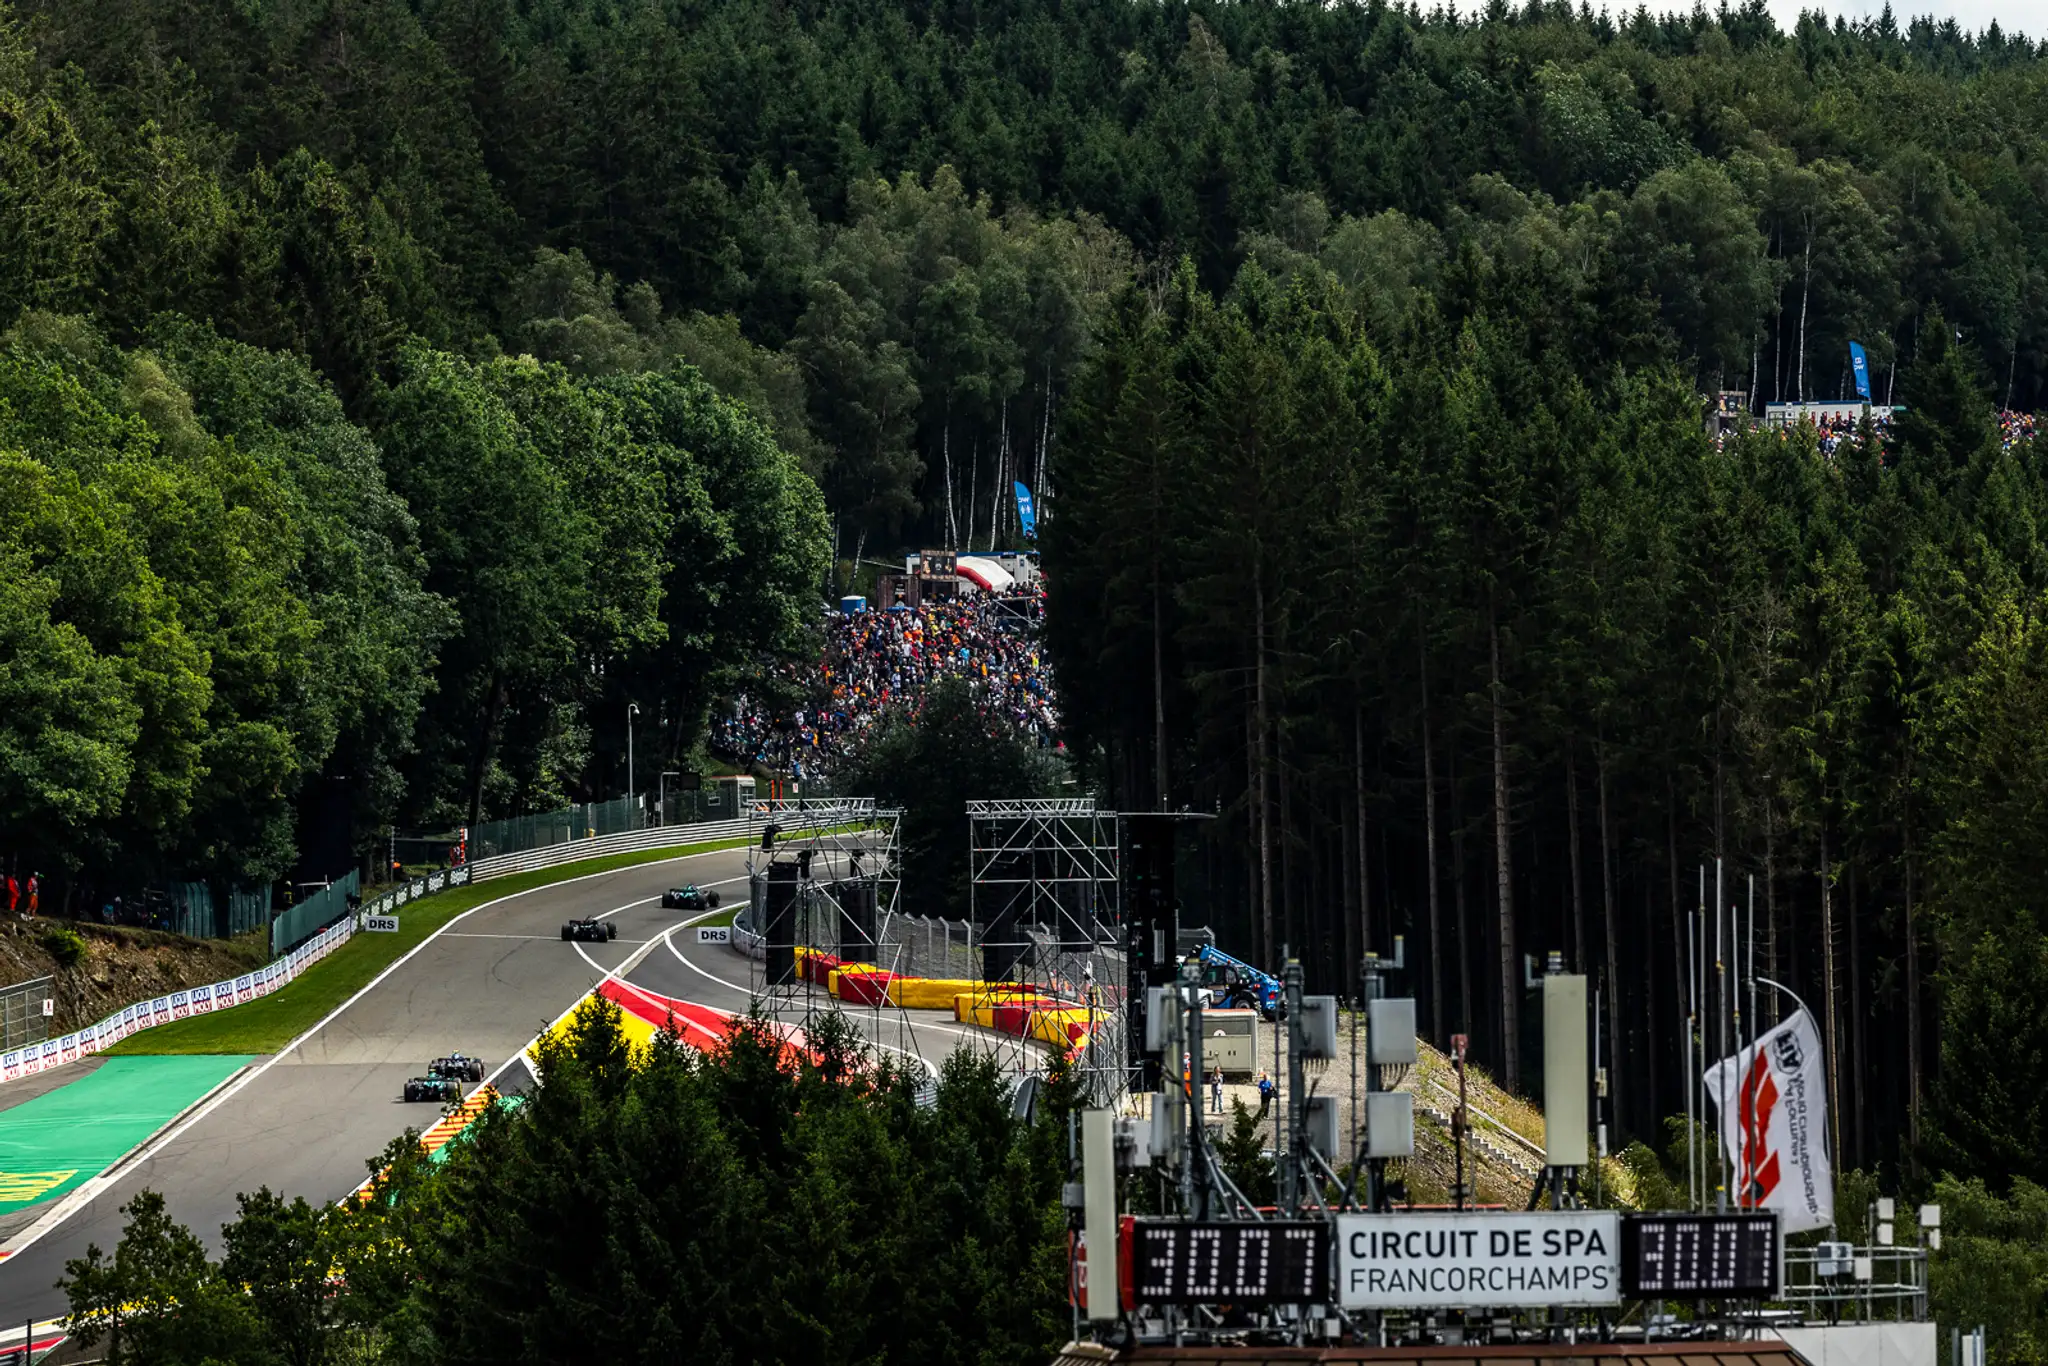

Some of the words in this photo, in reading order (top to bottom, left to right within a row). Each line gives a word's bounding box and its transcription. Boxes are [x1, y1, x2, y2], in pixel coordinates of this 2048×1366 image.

[369, 920, 395, 929] DRS
[701, 930, 727, 940] DRS
[191, 987, 210, 1003] LIQUI
[193, 1000, 212, 1014] MOLY
[1349, 1230, 1478, 1259] CIRCUIT
[1490, 1230, 1532, 1257] DE
[1542, 1229, 1607, 1257] SPA
[1142, 1229, 1316, 1296] 30.07
[1639, 1222, 1772, 1290] 30.07
